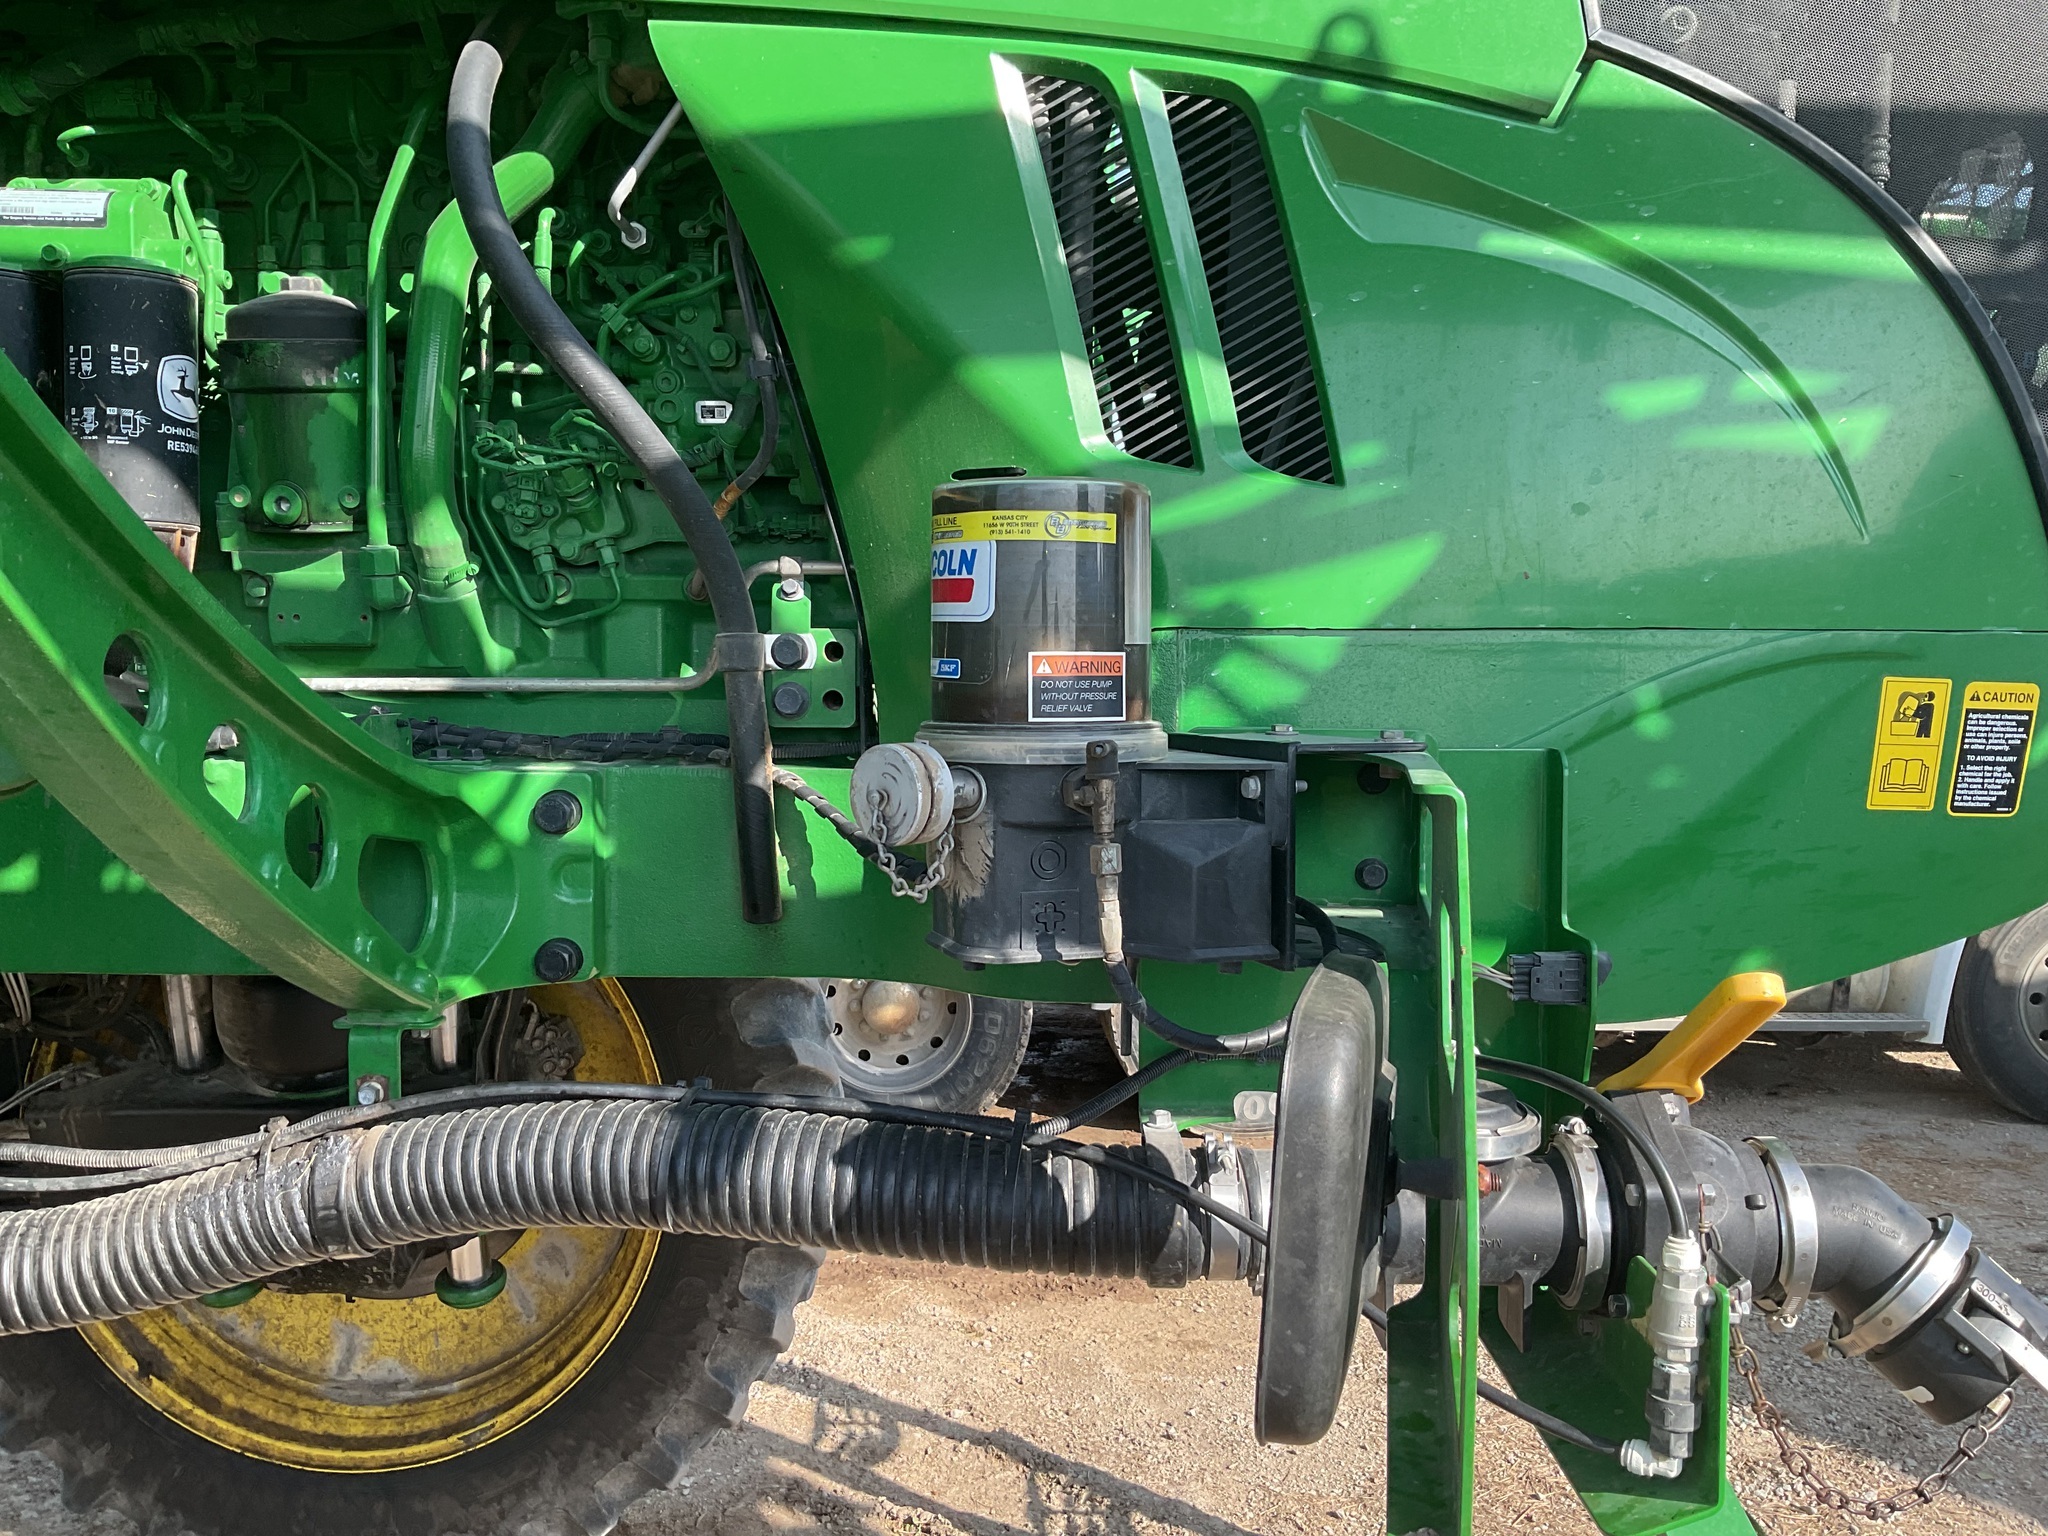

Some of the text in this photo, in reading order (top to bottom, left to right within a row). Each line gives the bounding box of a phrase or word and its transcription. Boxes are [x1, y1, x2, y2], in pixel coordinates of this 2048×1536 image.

[158, 424, 185, 436] JOHN
[943, 516, 957, 525] LINE
[1055, 661, 1120, 673] WARNING
[1040, 680, 1112, 688] DO NOT USE PUMP
[1080, 692, 1117, 700] PRESSURE
[1983, 692, 2034, 703] CAUTION
[1070, 704, 1094, 712] VALVE
[1852, 1203, 1884, 1221] BANJO
[1833, 1206, 1898, 1239] MADE IN USA
